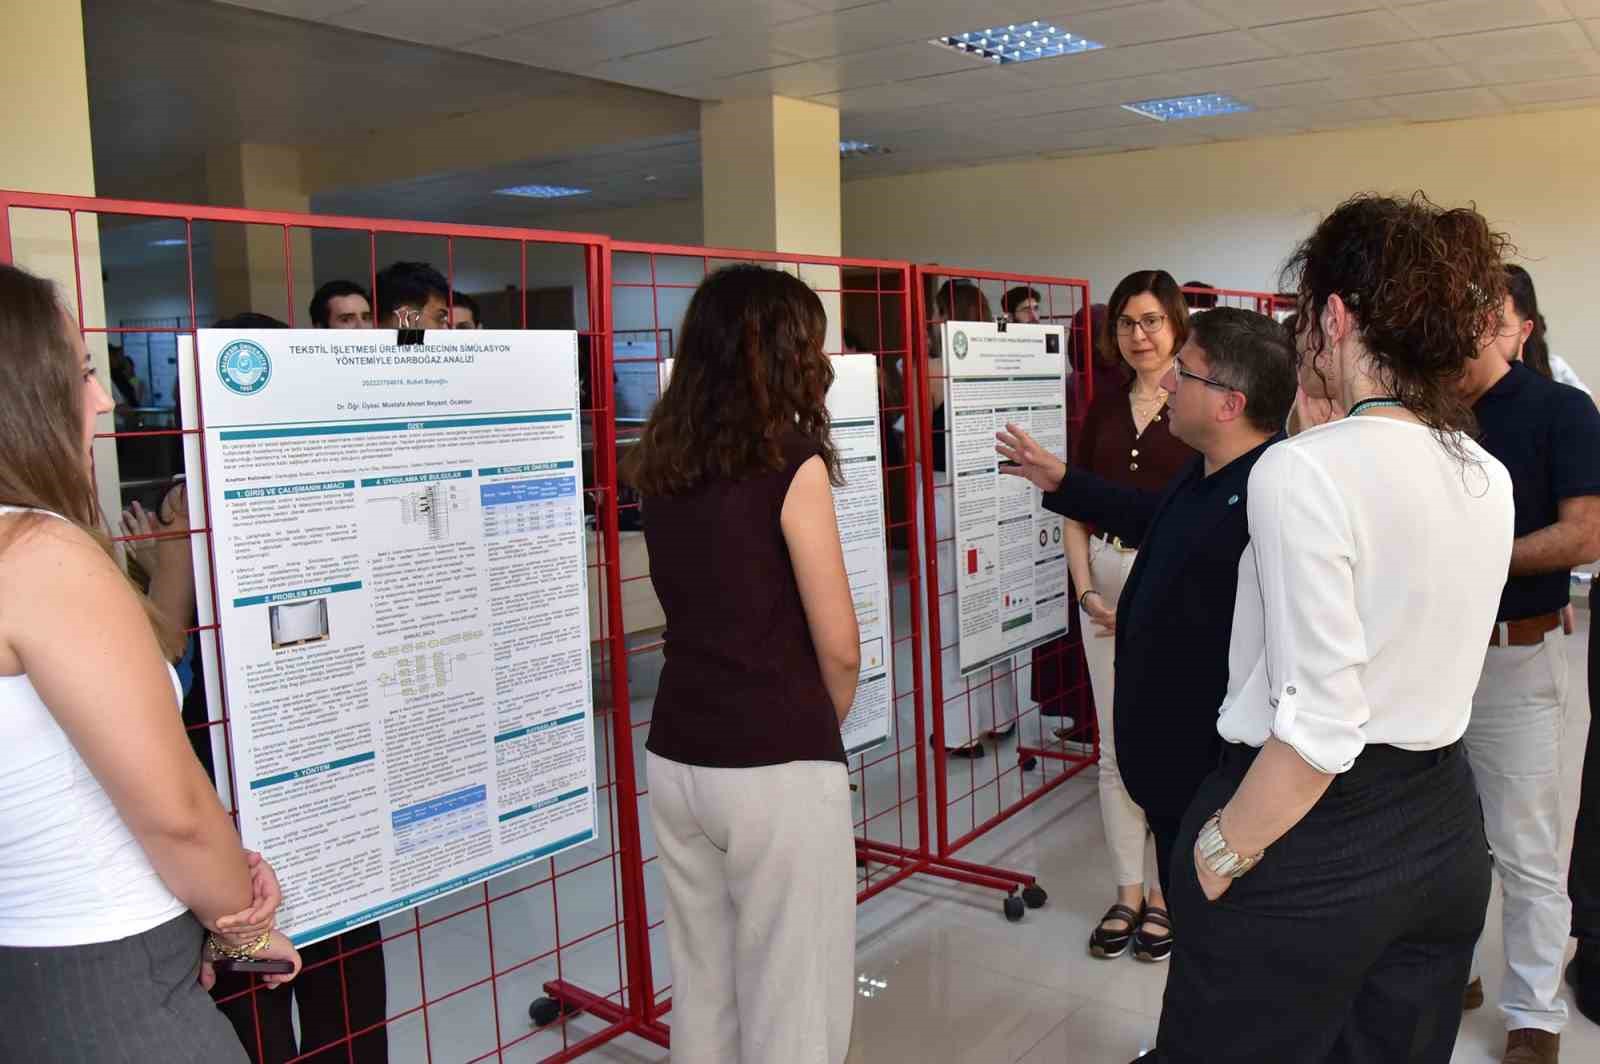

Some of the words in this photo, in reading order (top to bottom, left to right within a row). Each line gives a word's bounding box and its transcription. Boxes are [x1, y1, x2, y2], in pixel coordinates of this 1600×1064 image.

[289, 344, 328, 354] TEKSTİL
[331, 343, 377, 355] İŞLETMESİ
[460, 343, 511, 353] SİMÜLASYON
[336, 355, 393, 366] YÖNTEMİYLE
[394, 355, 441, 365] DARBOĞAZ
[443, 354, 474, 364] ANALİZİ
[267, 487, 276, 497] VE
[272, 589, 308, 602] PROBLEM
[301, 763, 331, 777] YÖNTEM
